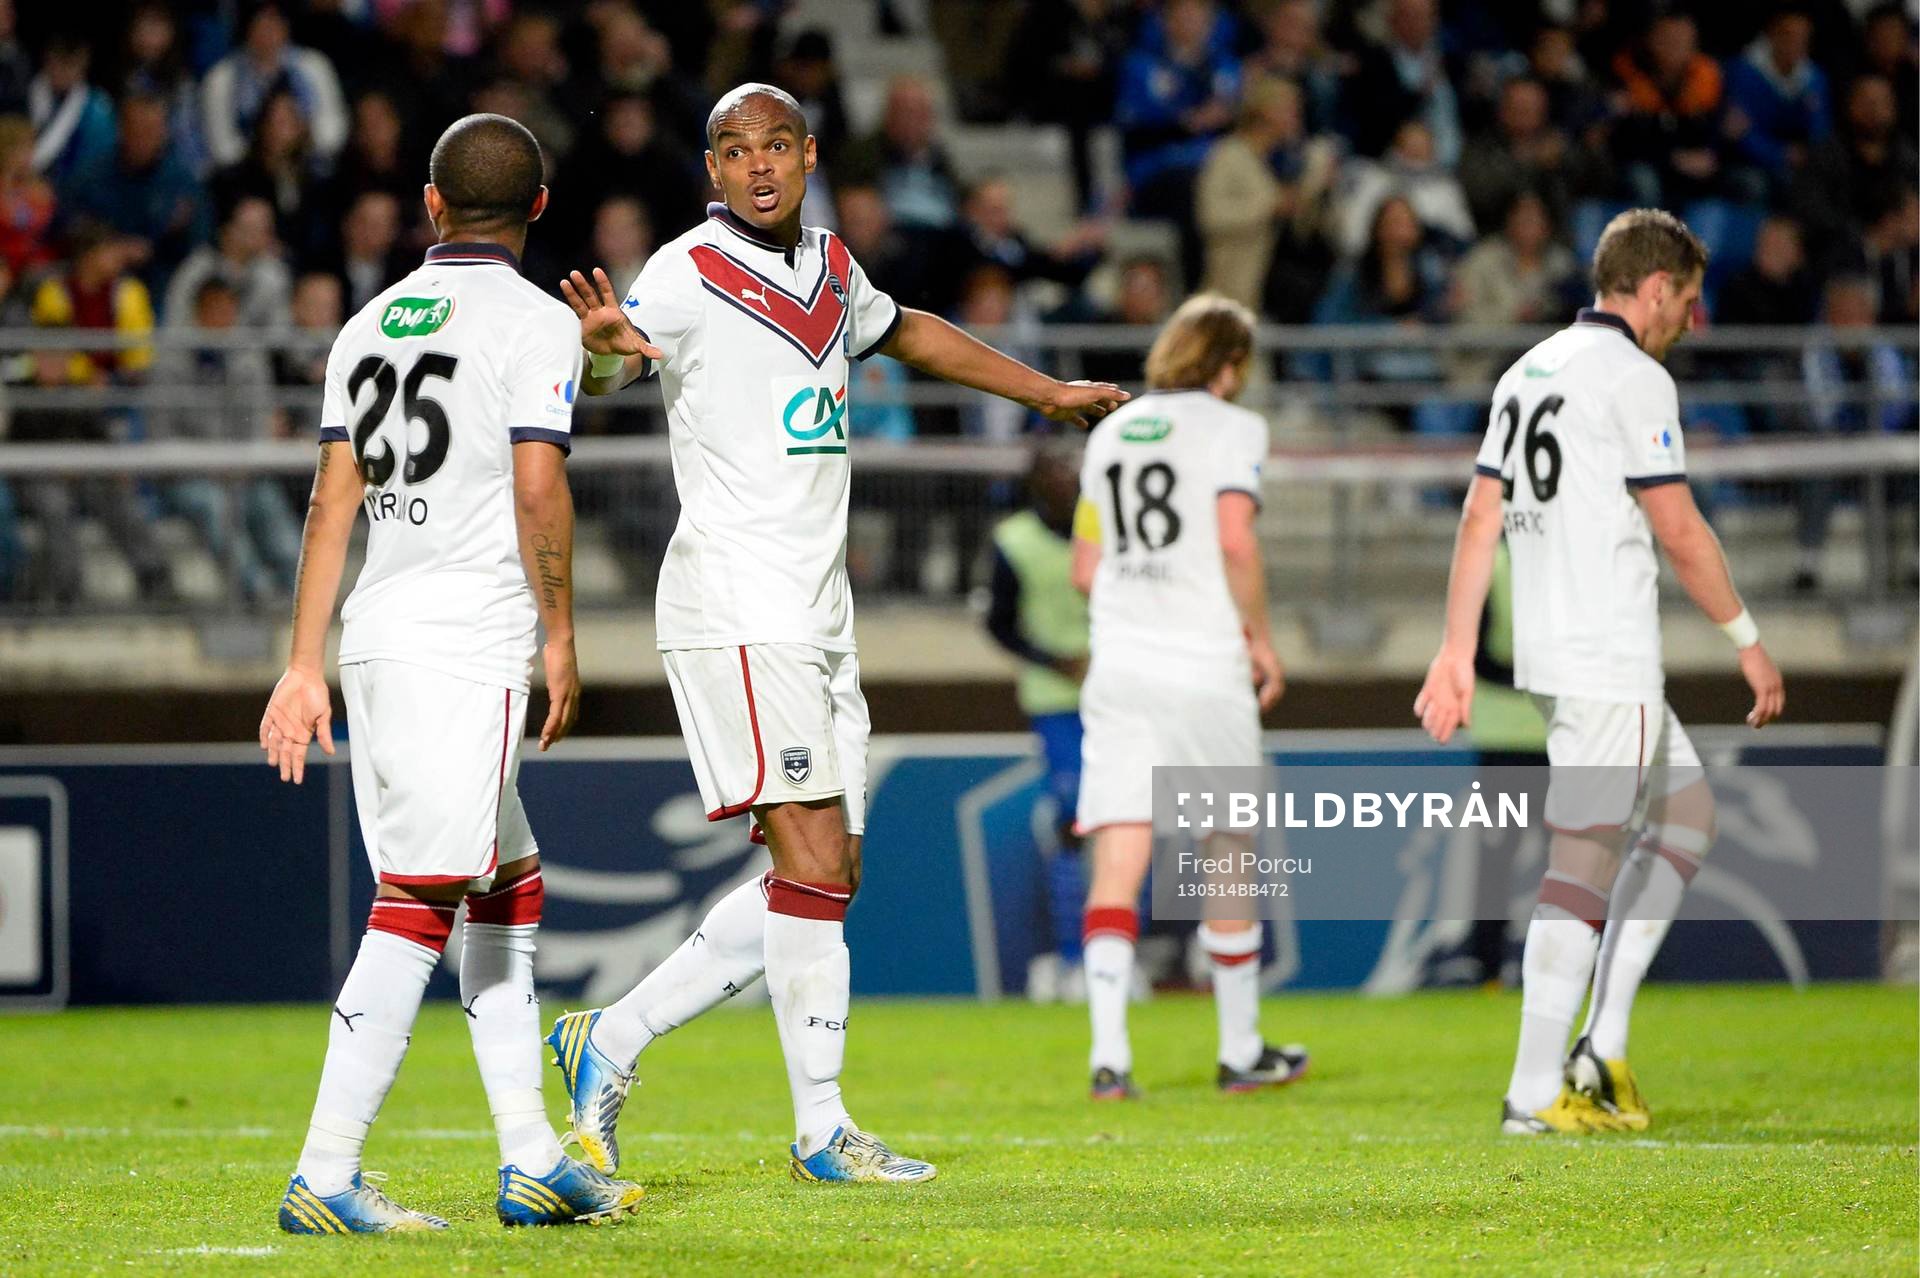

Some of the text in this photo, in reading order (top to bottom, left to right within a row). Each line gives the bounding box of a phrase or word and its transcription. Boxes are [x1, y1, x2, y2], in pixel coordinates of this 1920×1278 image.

[347, 351, 459, 486] 25
[1498, 395, 1566, 503] 26
[1106, 461, 1182, 553] 18
